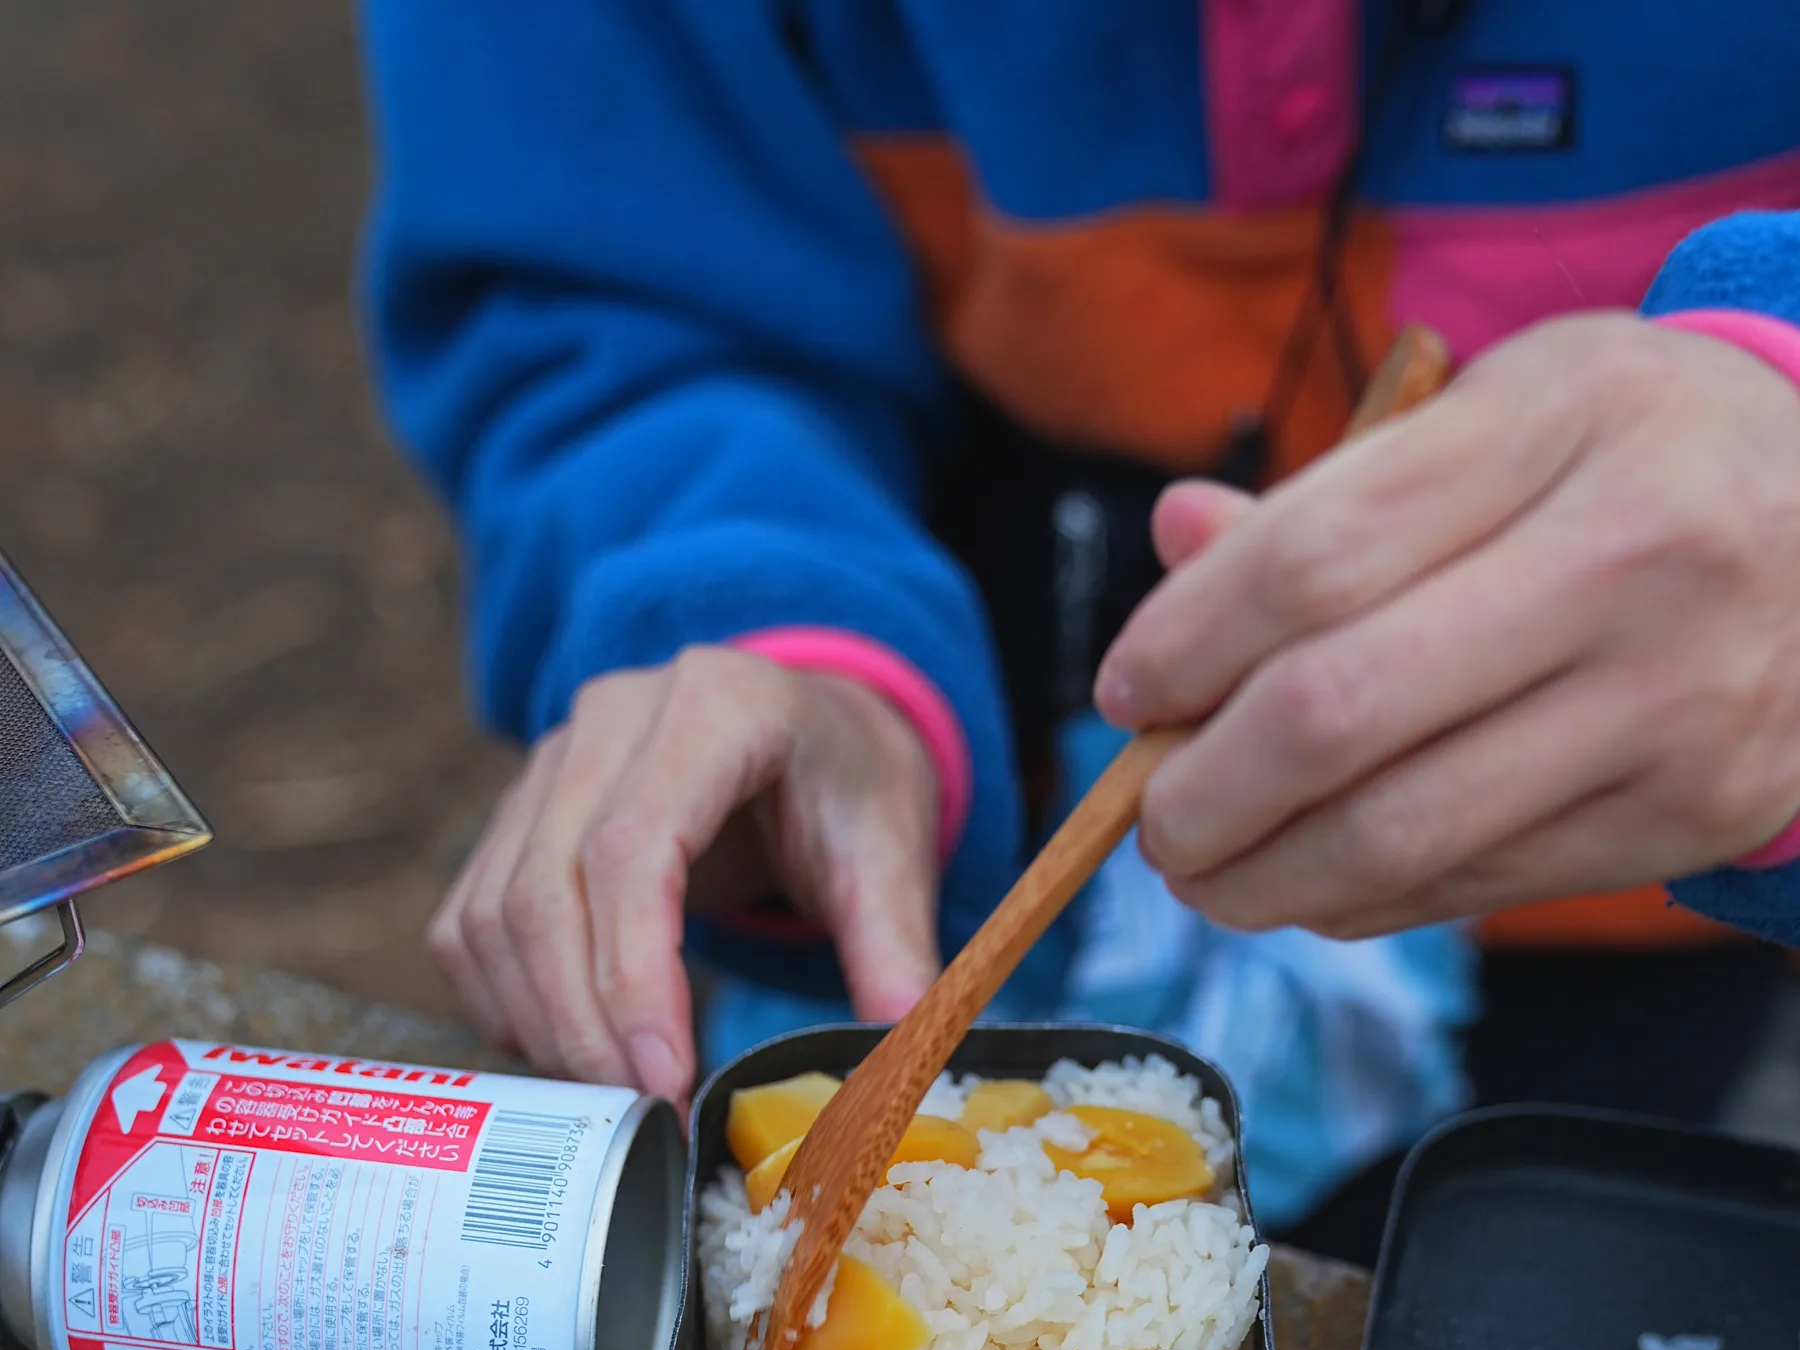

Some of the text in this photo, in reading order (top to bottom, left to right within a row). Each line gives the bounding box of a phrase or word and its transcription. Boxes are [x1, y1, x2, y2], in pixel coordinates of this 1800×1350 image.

[204, 1116, 461, 1162] わせてセットしてください
[214, 1095, 471, 1140] の容器受けガイド凸部に合
[136, 1195, 191, 1214] 切込み凹部
[537, 1119, 588, 1269] 4 901140 908736
[71, 1234, 94, 1284] 警告
[107, 1229, 121, 1326] 容器受けガイド凸部
